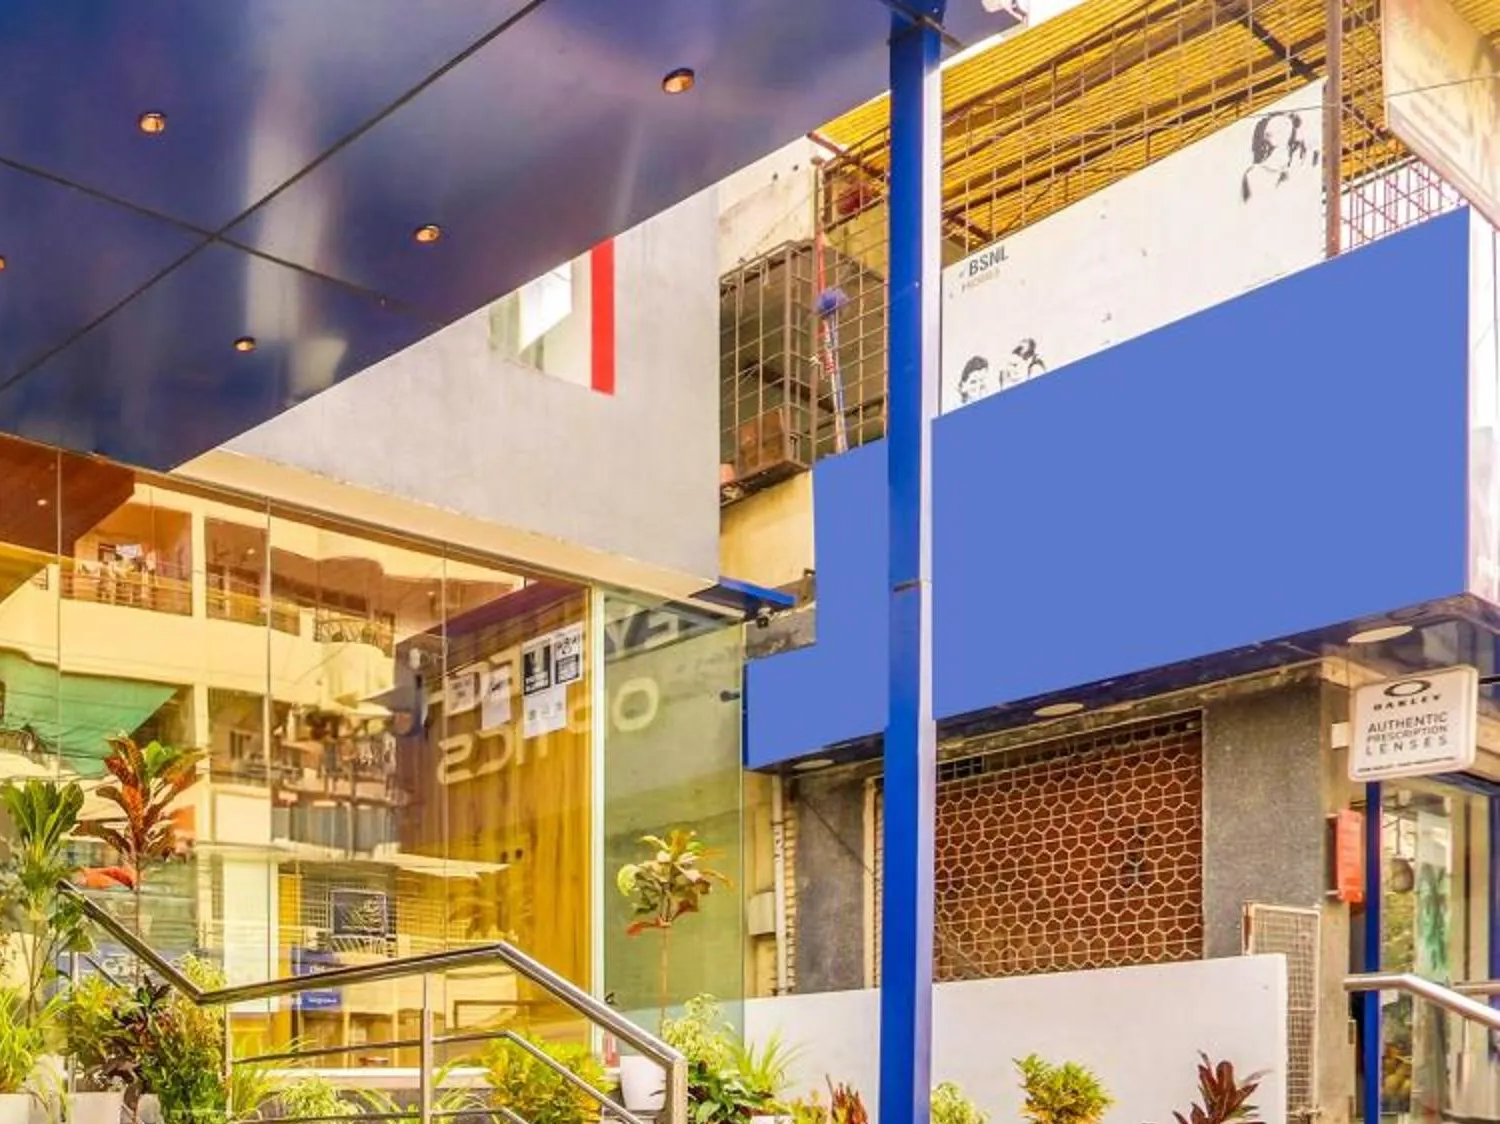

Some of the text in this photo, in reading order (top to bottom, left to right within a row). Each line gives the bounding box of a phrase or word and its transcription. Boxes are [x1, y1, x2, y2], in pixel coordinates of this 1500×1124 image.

[968, 245, 1009, 276] BSNL
[1367, 711, 1448, 733] AUTHENTIC
[1367, 725, 1448, 743] PRESCRIPTION
[1365, 735, 1448, 756] LENSES
